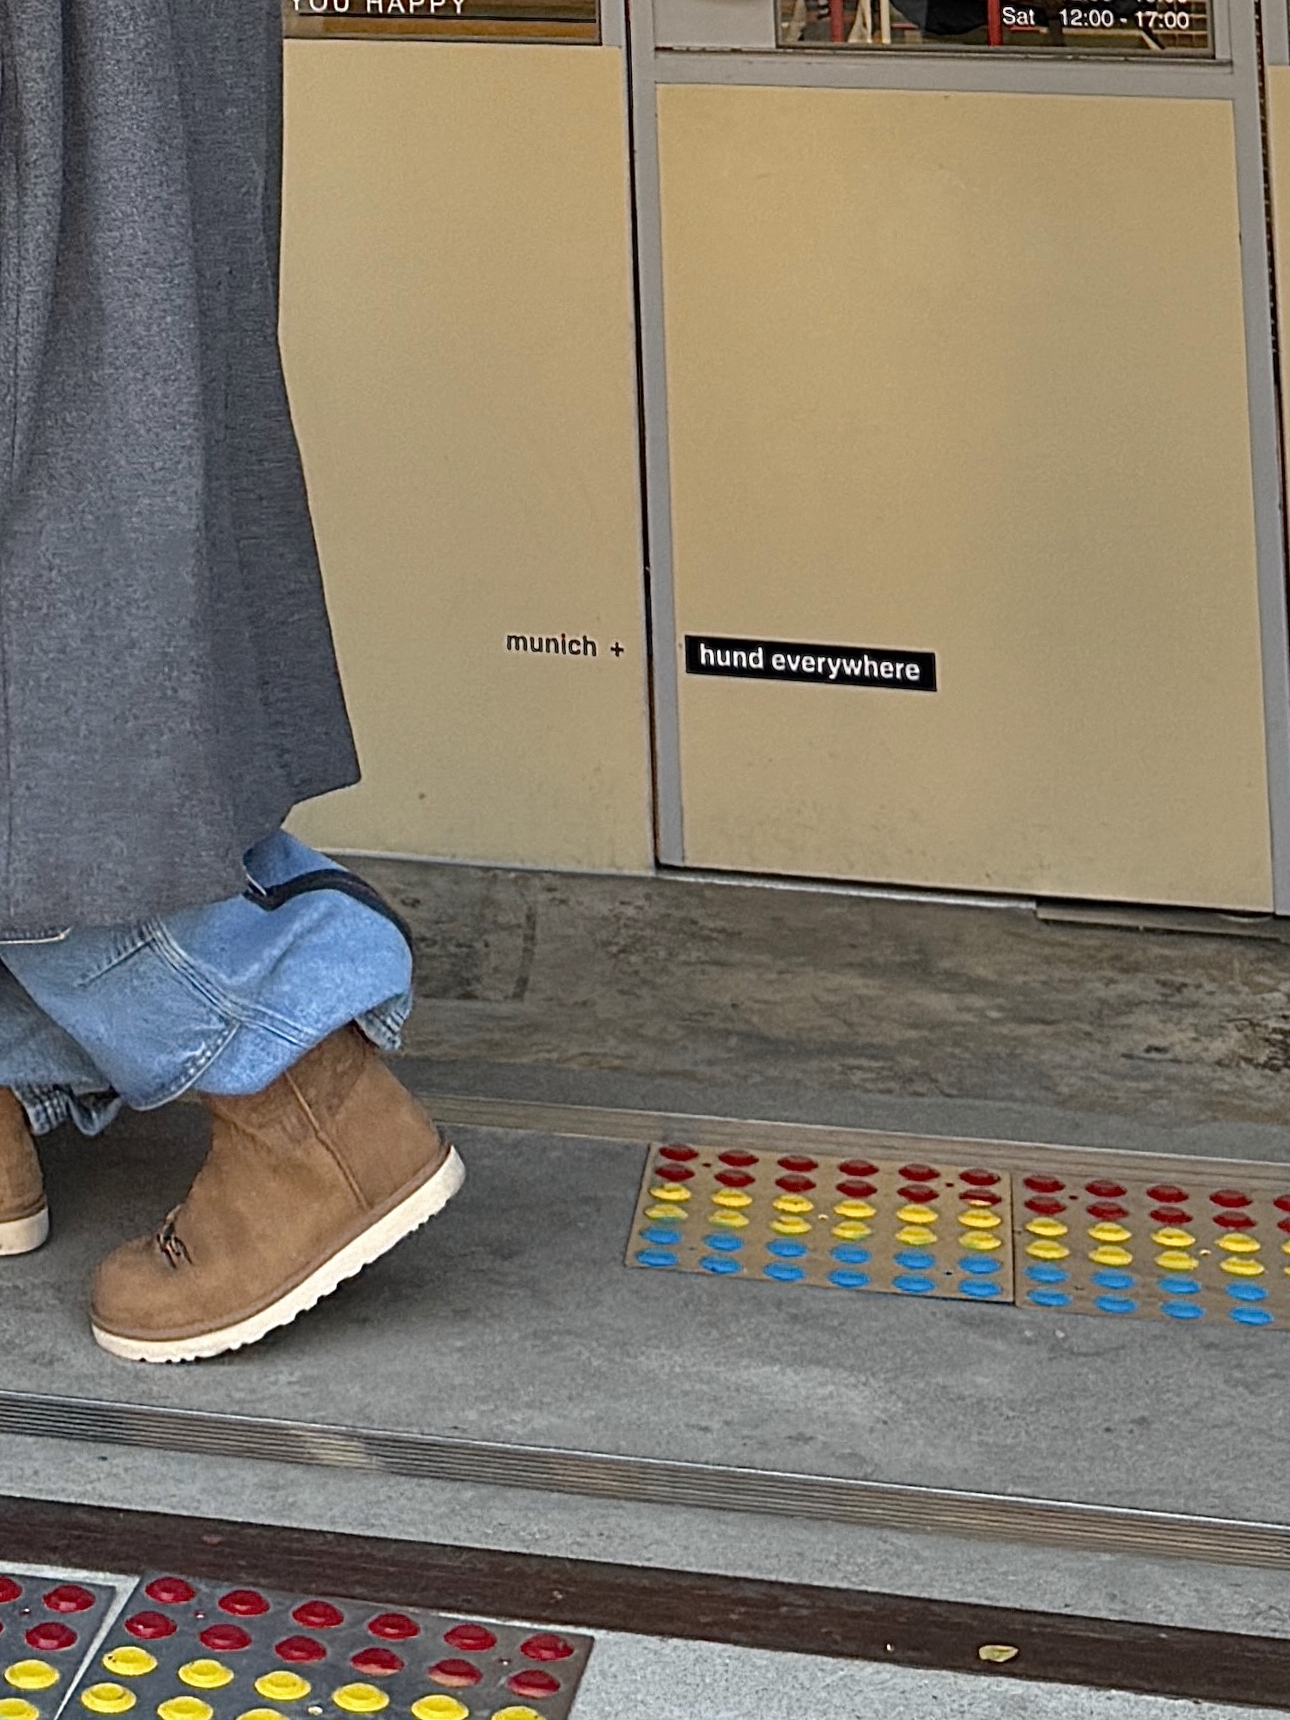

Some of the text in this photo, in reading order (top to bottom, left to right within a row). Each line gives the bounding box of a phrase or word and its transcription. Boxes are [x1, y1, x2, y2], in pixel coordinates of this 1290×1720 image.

[1002, 6, 1036, 26] Sat
[1058, 8, 1114, 27] 12:00
[1134, 10, 1190, 30] 17:00
[506, 633, 597, 657] munich
[699, 642, 921, 681] hund everywhere
